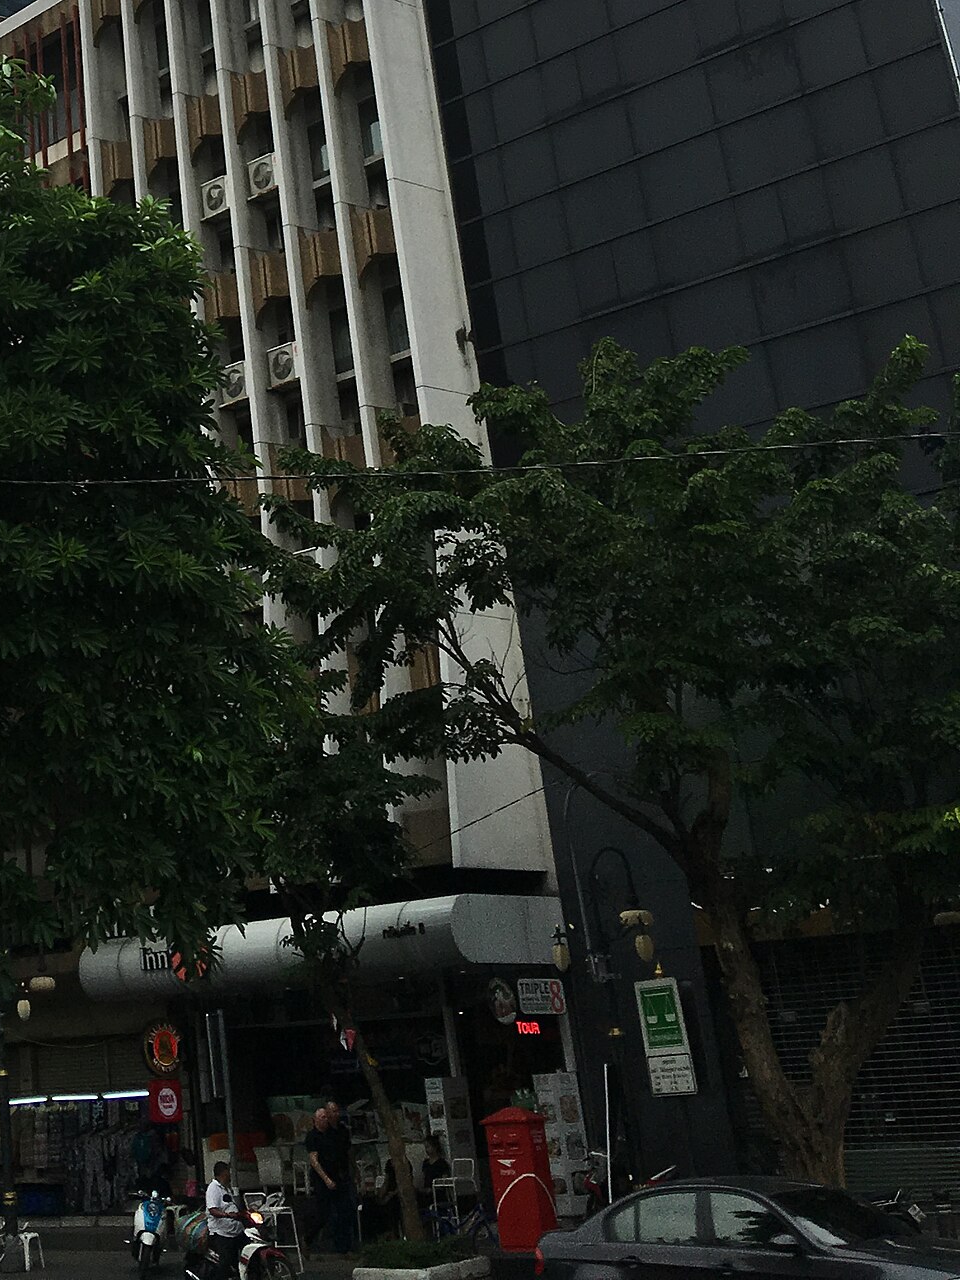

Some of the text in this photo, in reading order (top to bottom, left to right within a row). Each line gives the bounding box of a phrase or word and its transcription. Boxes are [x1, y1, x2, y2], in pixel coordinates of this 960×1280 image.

[519, 982, 550, 995] TRIPLE
[550, 980, 565, 1013] 8
[516, 1021, 541, 1035] TOUR
